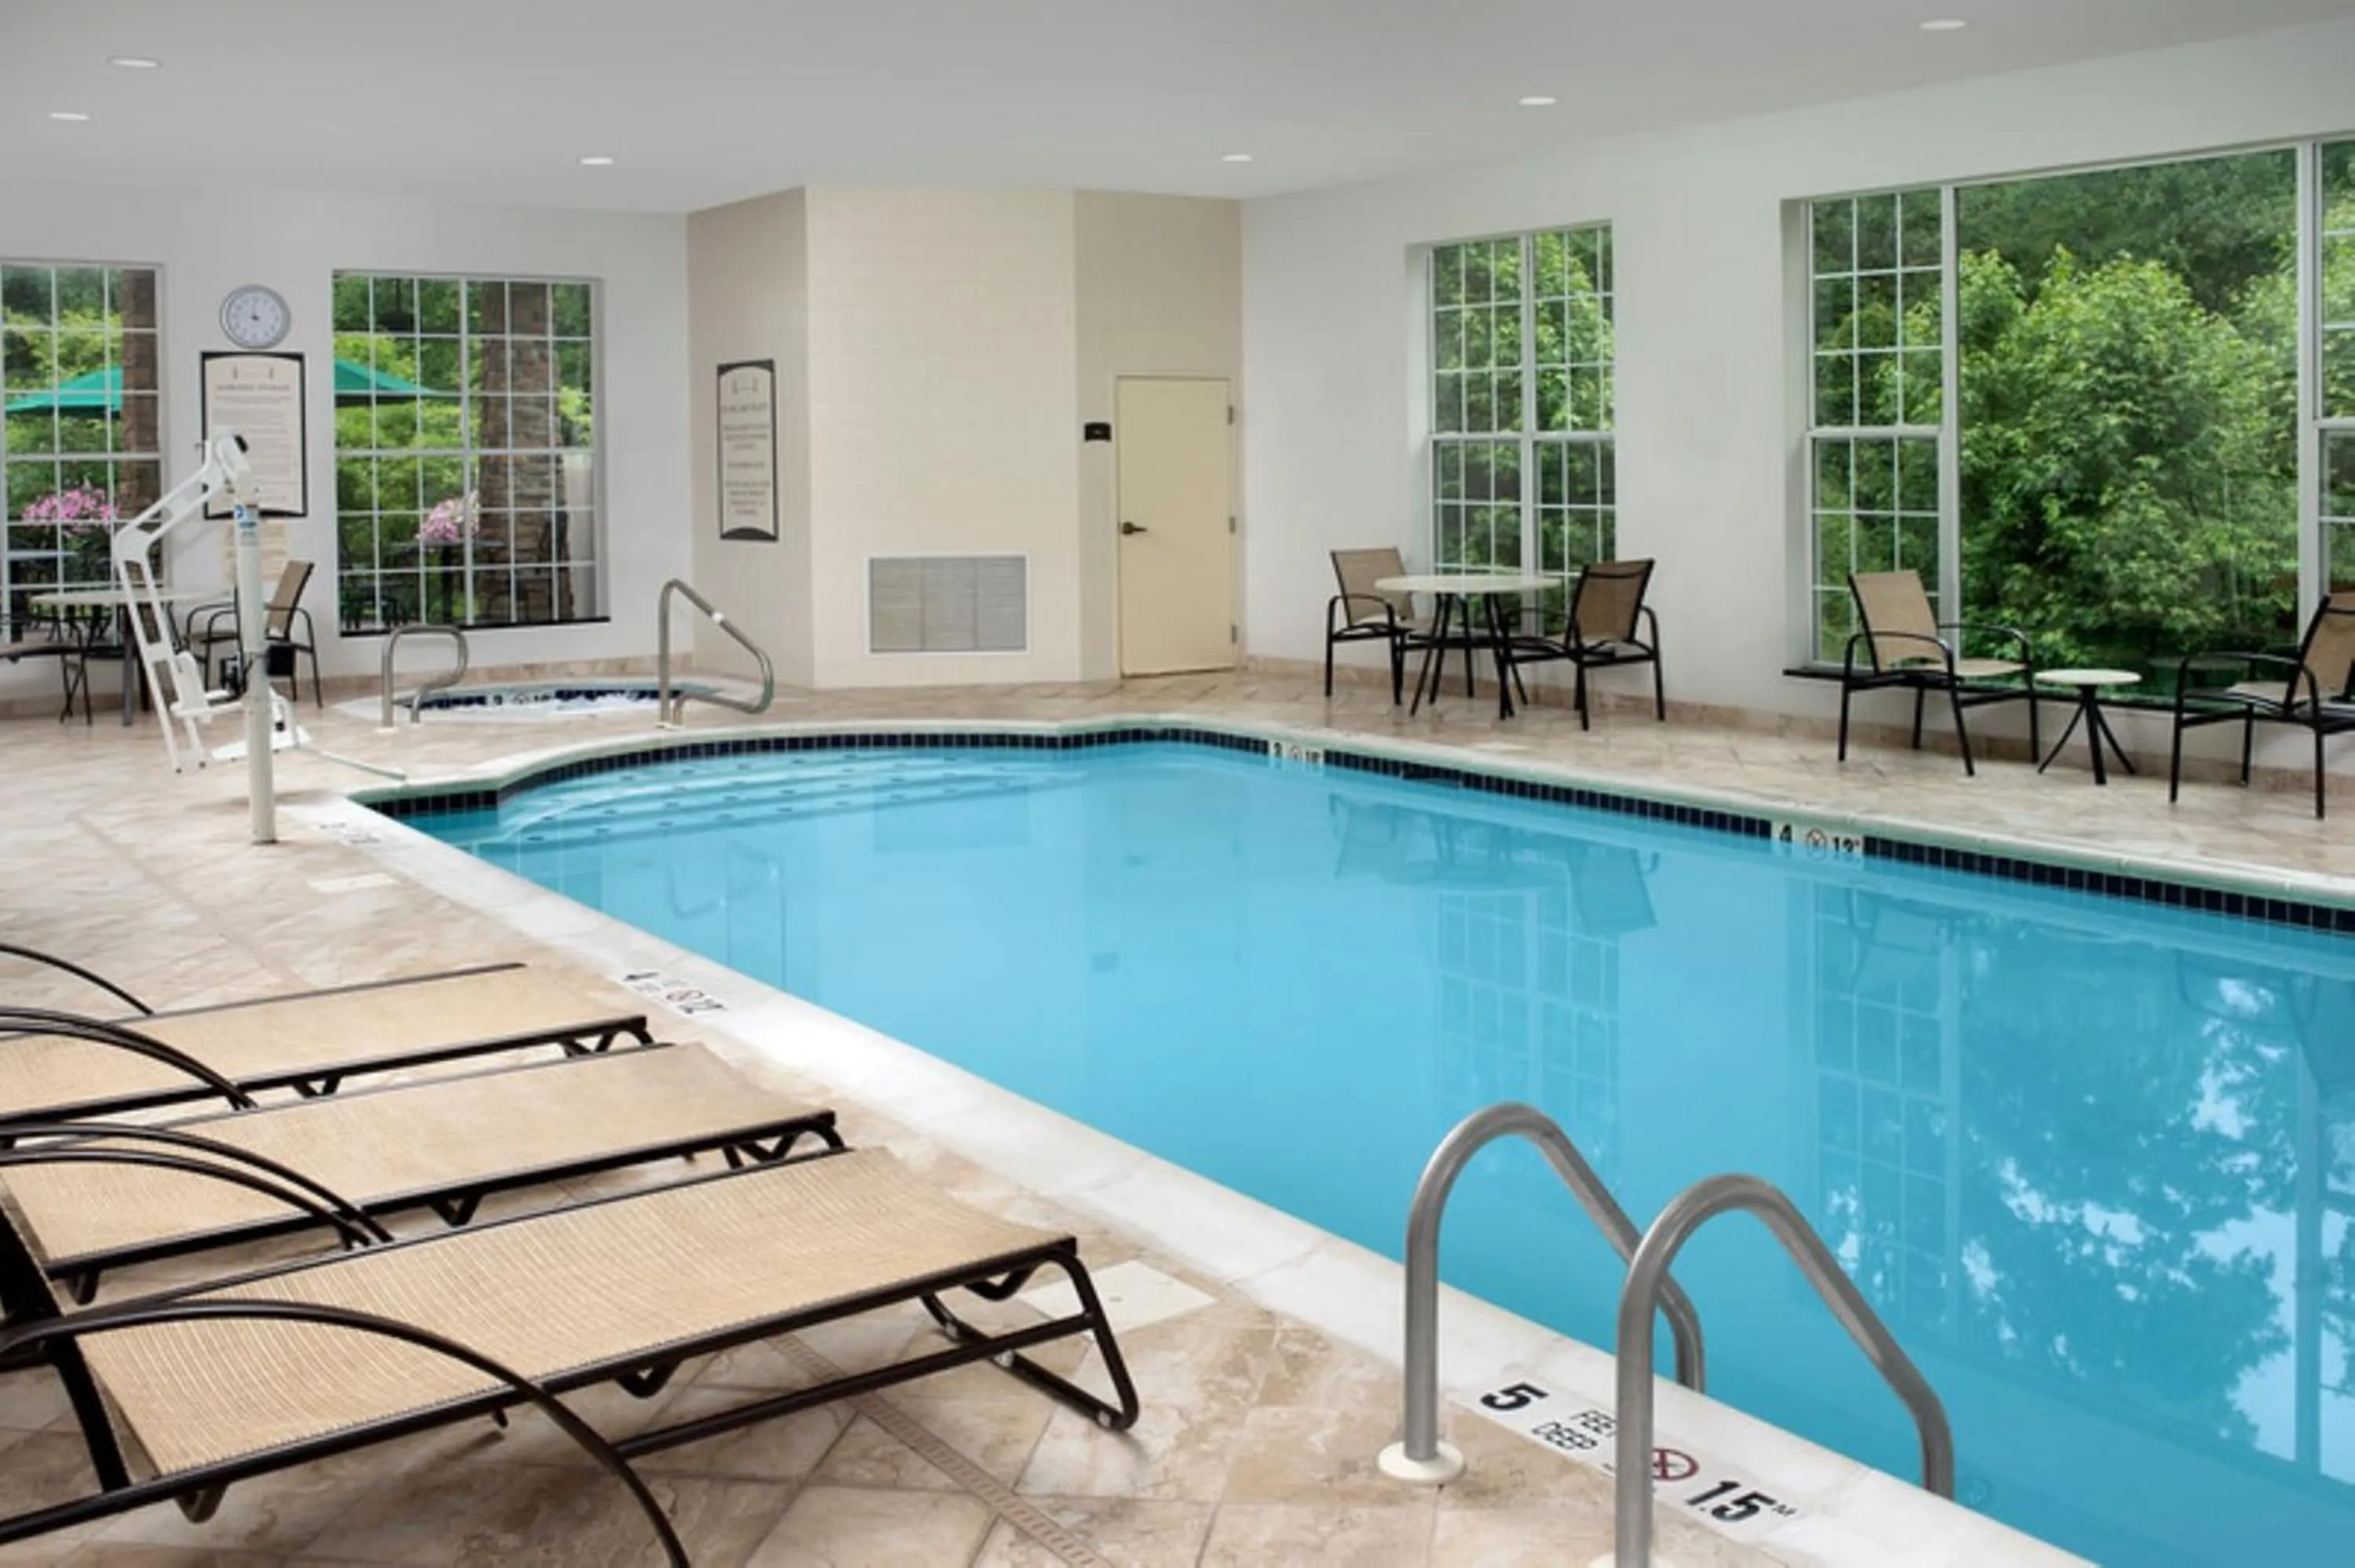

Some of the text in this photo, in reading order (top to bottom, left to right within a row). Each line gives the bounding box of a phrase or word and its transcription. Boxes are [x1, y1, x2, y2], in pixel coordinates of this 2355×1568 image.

[1780, 824, 1792, 843] 4
[1481, 1383, 1549, 1411] 5
[1532, 1421, 1599, 1449] DEEP
